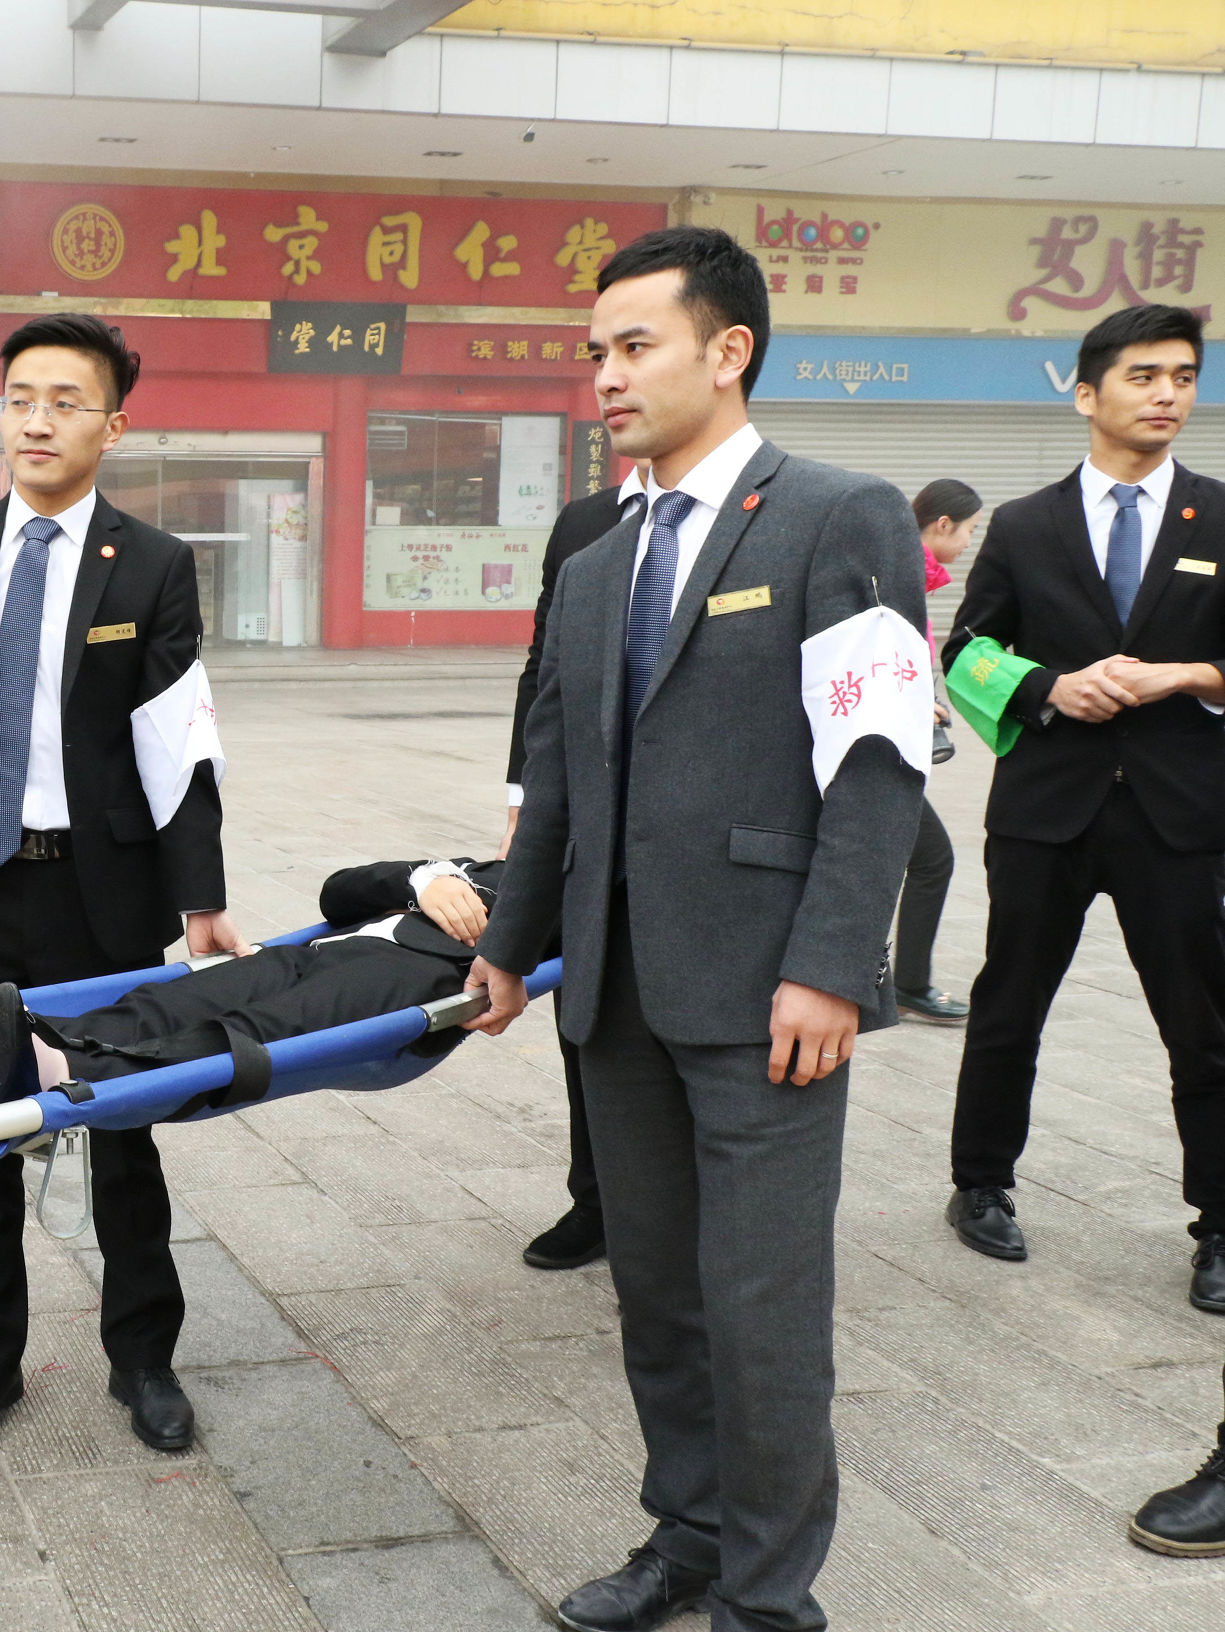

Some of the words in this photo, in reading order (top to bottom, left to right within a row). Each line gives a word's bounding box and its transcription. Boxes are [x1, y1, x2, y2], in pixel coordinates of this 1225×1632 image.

[163, 205, 618, 294] 北京同仁堂
[1008, 215, 1208, 321] 女人街
[471, 340, 593, 360] 滨湖新区
[796, 359, 909, 383] 女人街出入口
